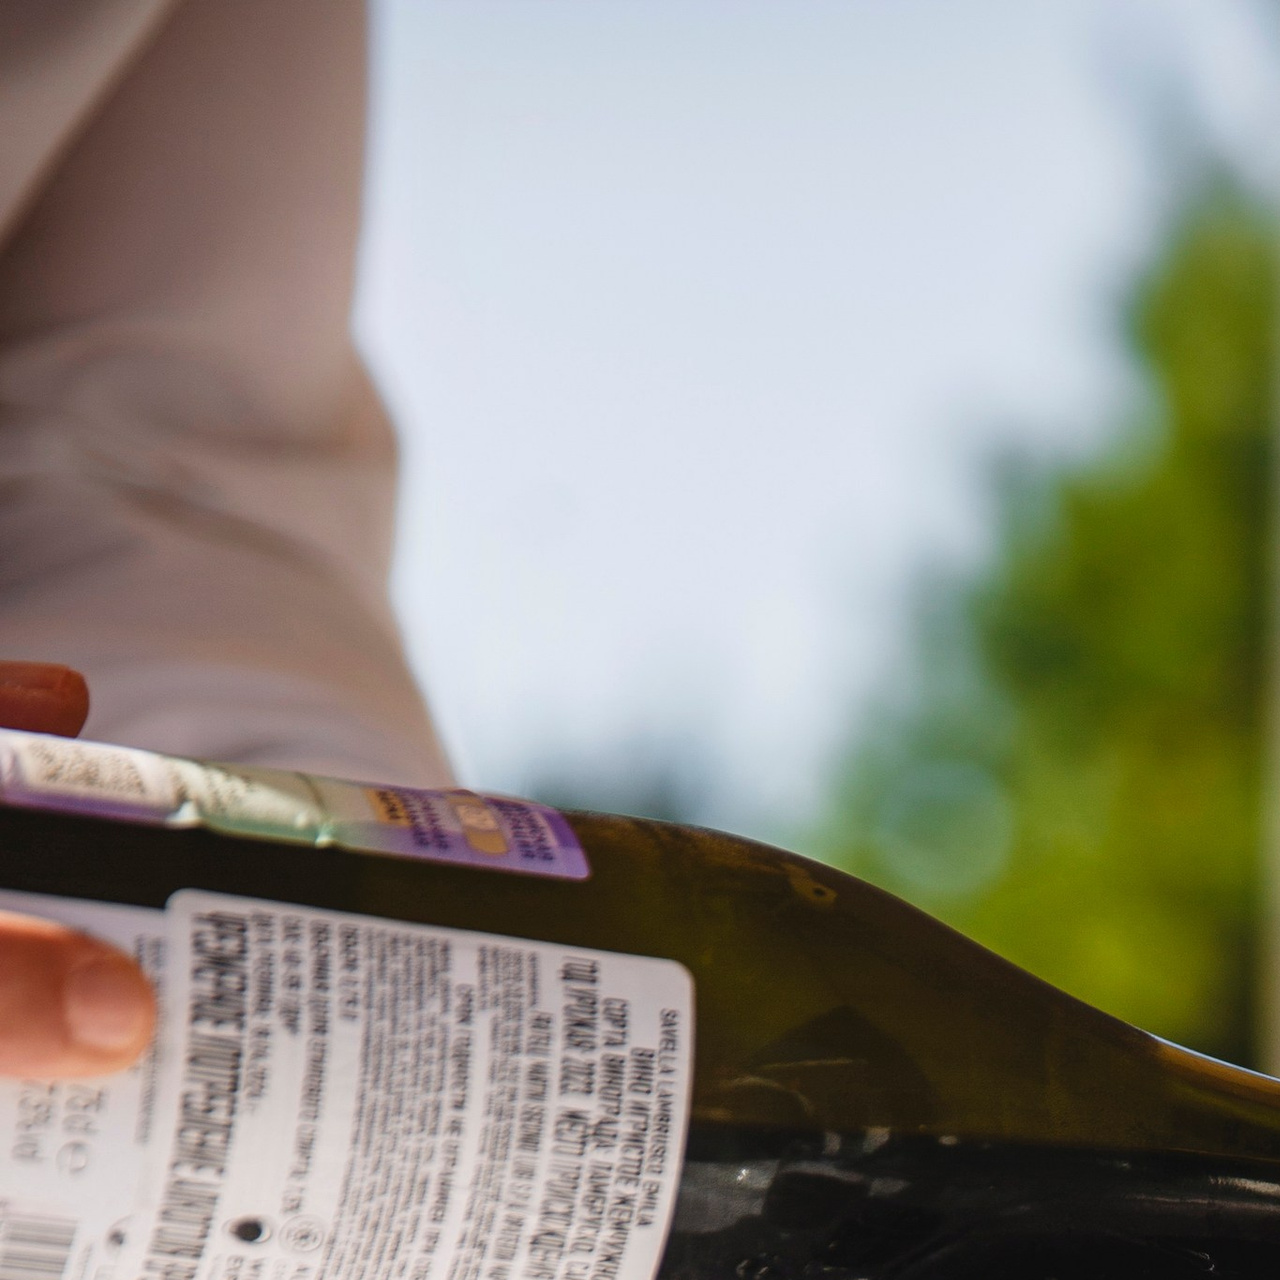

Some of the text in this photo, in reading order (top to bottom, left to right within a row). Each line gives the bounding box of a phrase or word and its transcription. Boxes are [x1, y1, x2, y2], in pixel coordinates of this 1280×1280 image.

[560, 956, 601, 983] ГОД
[602, 998, 630, 1047] СОРТА
[628, 1047, 657, 1095] ВИНО
[171, 1034, 246, 1178] УПОТРЕБЛЕНИЕ
[552, 1108, 591, 1157] МЕСТО
[637, 1008, 680, 1226] SAVELLA LAMBRUSCO EMILIA
[615, 1099, 652, 1186] ИГРИСТОЕ
[528, 1160, 583, 1280] ПРОИСХОЖДЕНИЯ
